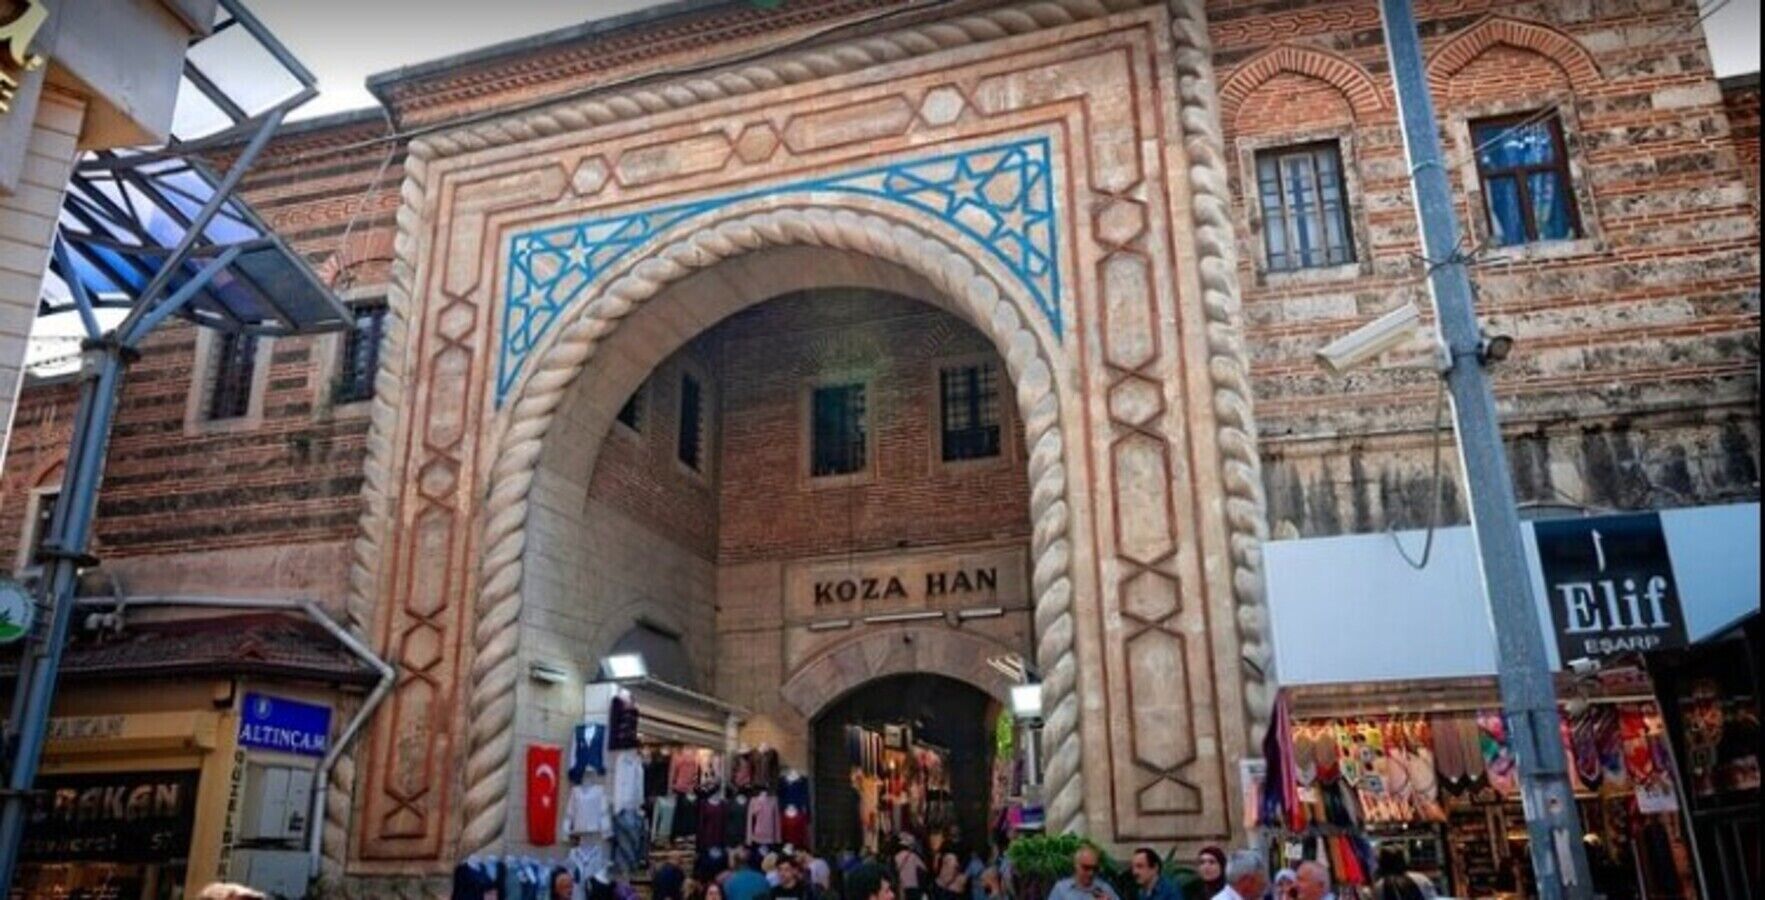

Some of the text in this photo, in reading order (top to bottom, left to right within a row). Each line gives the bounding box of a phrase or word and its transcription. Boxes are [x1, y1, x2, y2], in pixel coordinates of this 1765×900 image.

[814, 567, 997, 606] KOZA HAN
[1555, 575, 1672, 634] Elif
[1583, 634, 1660, 655] EŞARP
[239, 722, 327, 753] ALTINÇAM
